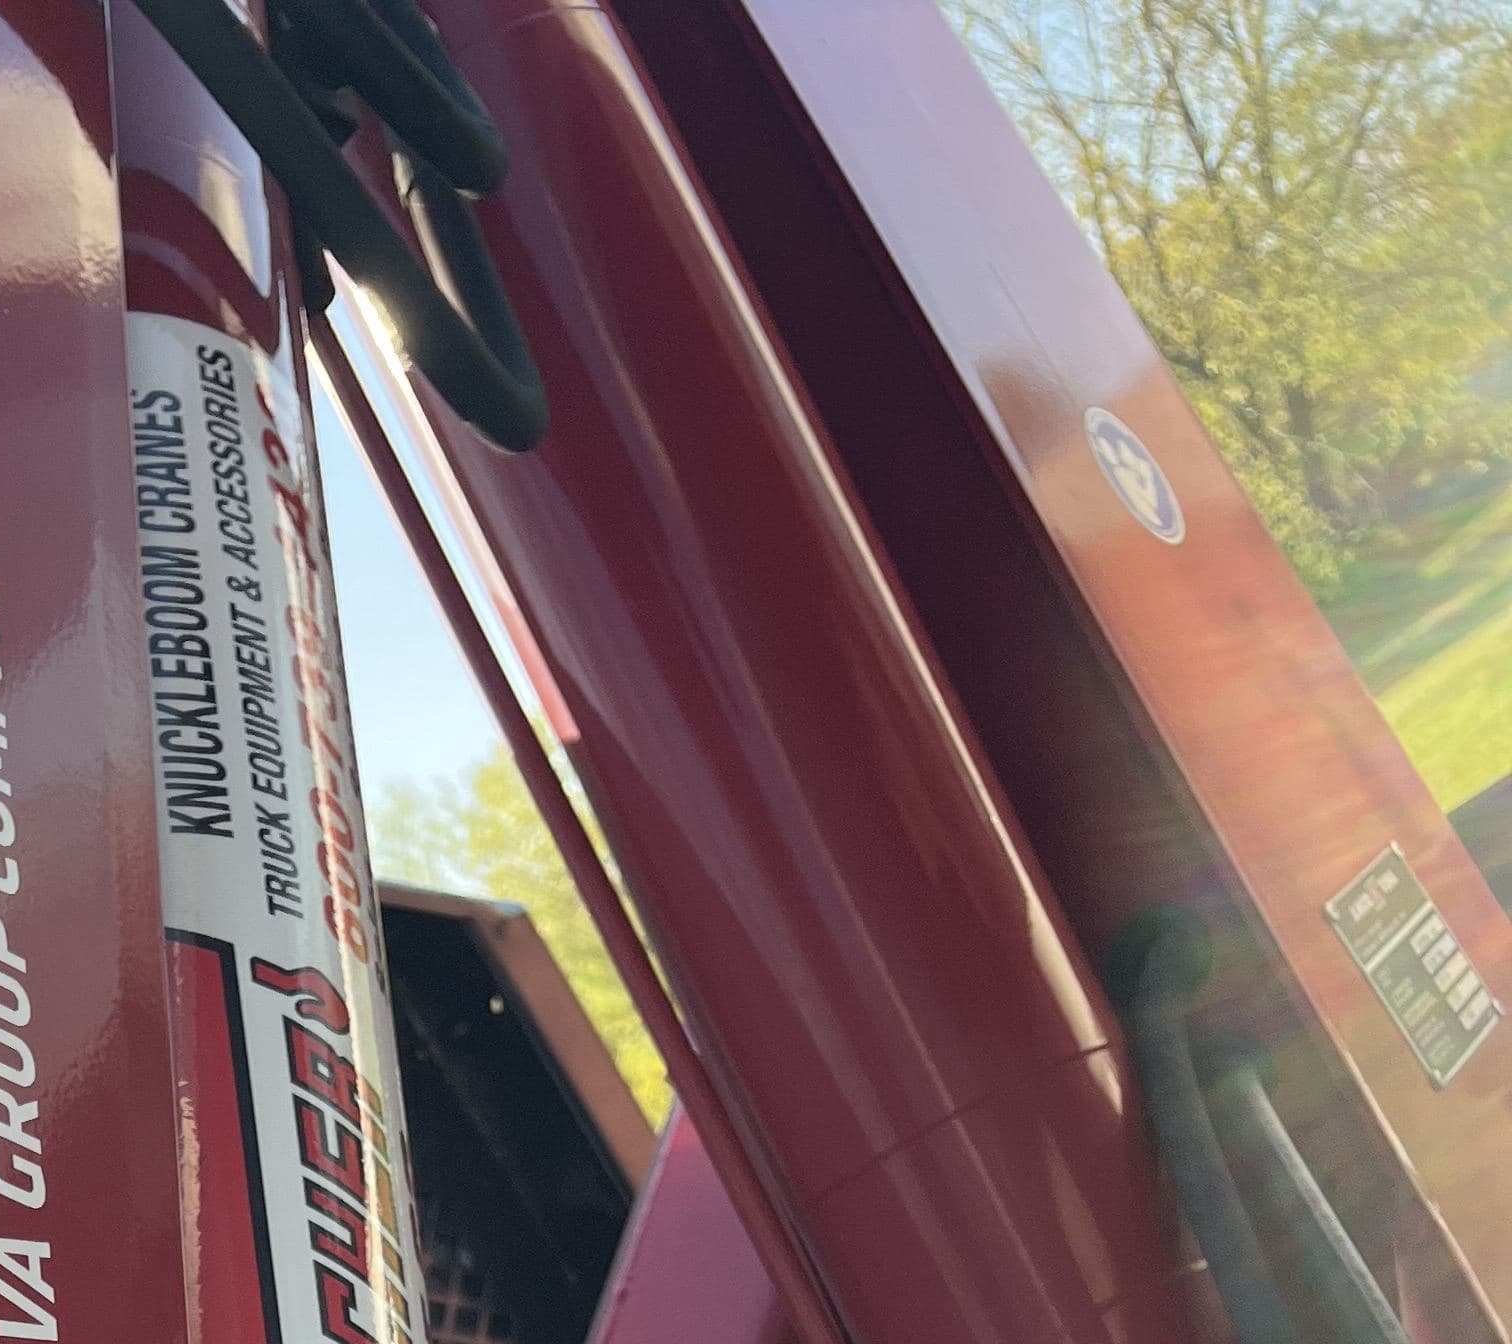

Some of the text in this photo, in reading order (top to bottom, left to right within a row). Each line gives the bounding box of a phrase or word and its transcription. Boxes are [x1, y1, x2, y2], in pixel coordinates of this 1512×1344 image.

[130, 389, 235, 840] KNUCKLEBOOM CRANES
[197, 344, 304, 920] TRUCK EQUIPMENT & ACCESSORIES
